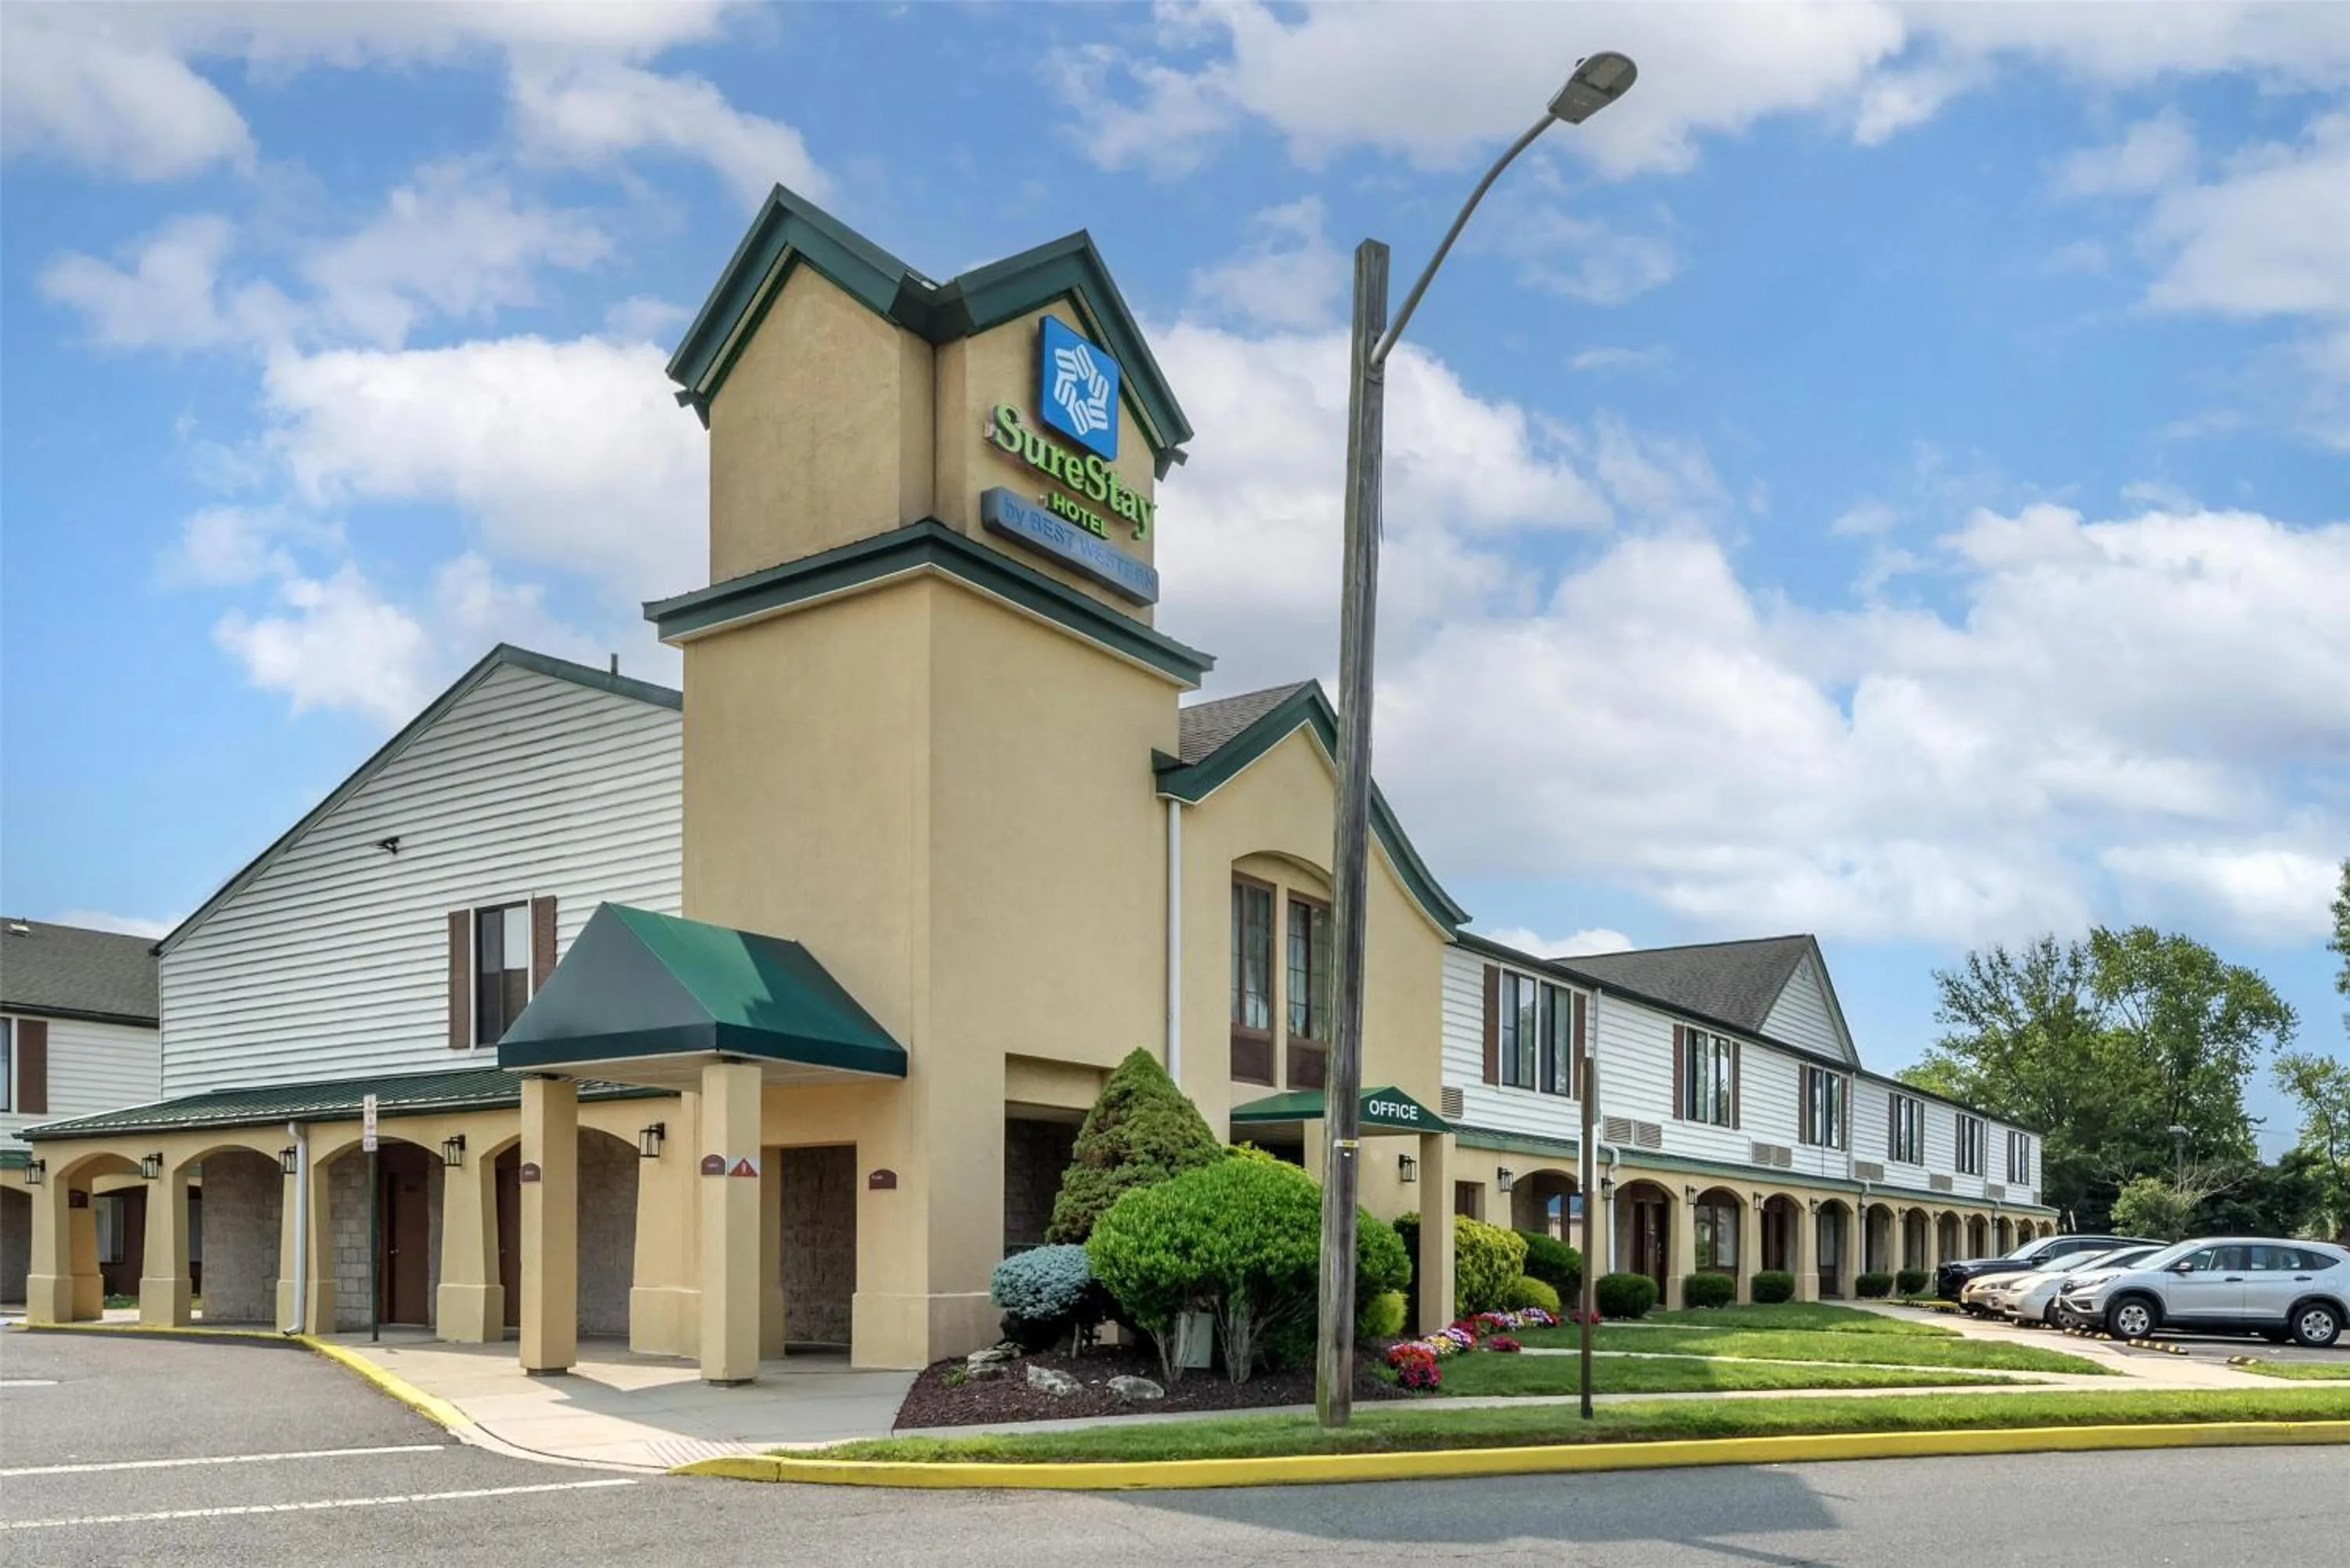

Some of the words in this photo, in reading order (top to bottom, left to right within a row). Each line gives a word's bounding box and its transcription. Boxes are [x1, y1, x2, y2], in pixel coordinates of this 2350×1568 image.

[994, 403, 1152, 540] SureStay
[1004, 496, 1025, 527] by
[1030, 509, 1075, 549] BEST
[1080, 538, 1154, 587] WESTERN
[1053, 492, 1108, 538] HOTEL
[1368, 1100, 1419, 1121] OFFICE
